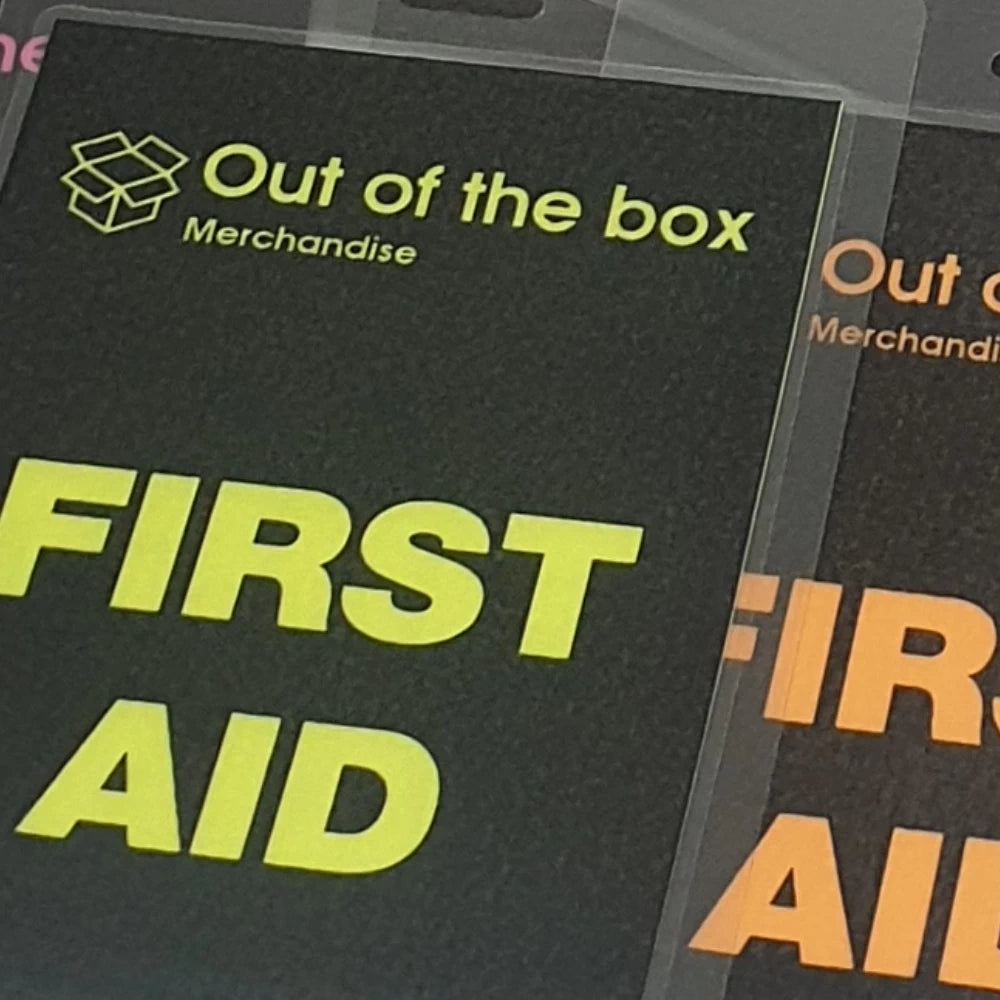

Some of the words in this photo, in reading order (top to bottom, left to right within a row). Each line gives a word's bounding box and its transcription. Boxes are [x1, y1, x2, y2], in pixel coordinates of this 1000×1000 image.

[183, 216, 418, 266] Merchandise
[202, 143, 343, 207] Out
[362, 164, 443, 219] of
[460, 171, 582, 235] the
[603, 183, 755, 254] box
[820, 238, 962, 308] Out
[0, 457, 644, 663] FIRST
[16, 699, 440, 877] AID
